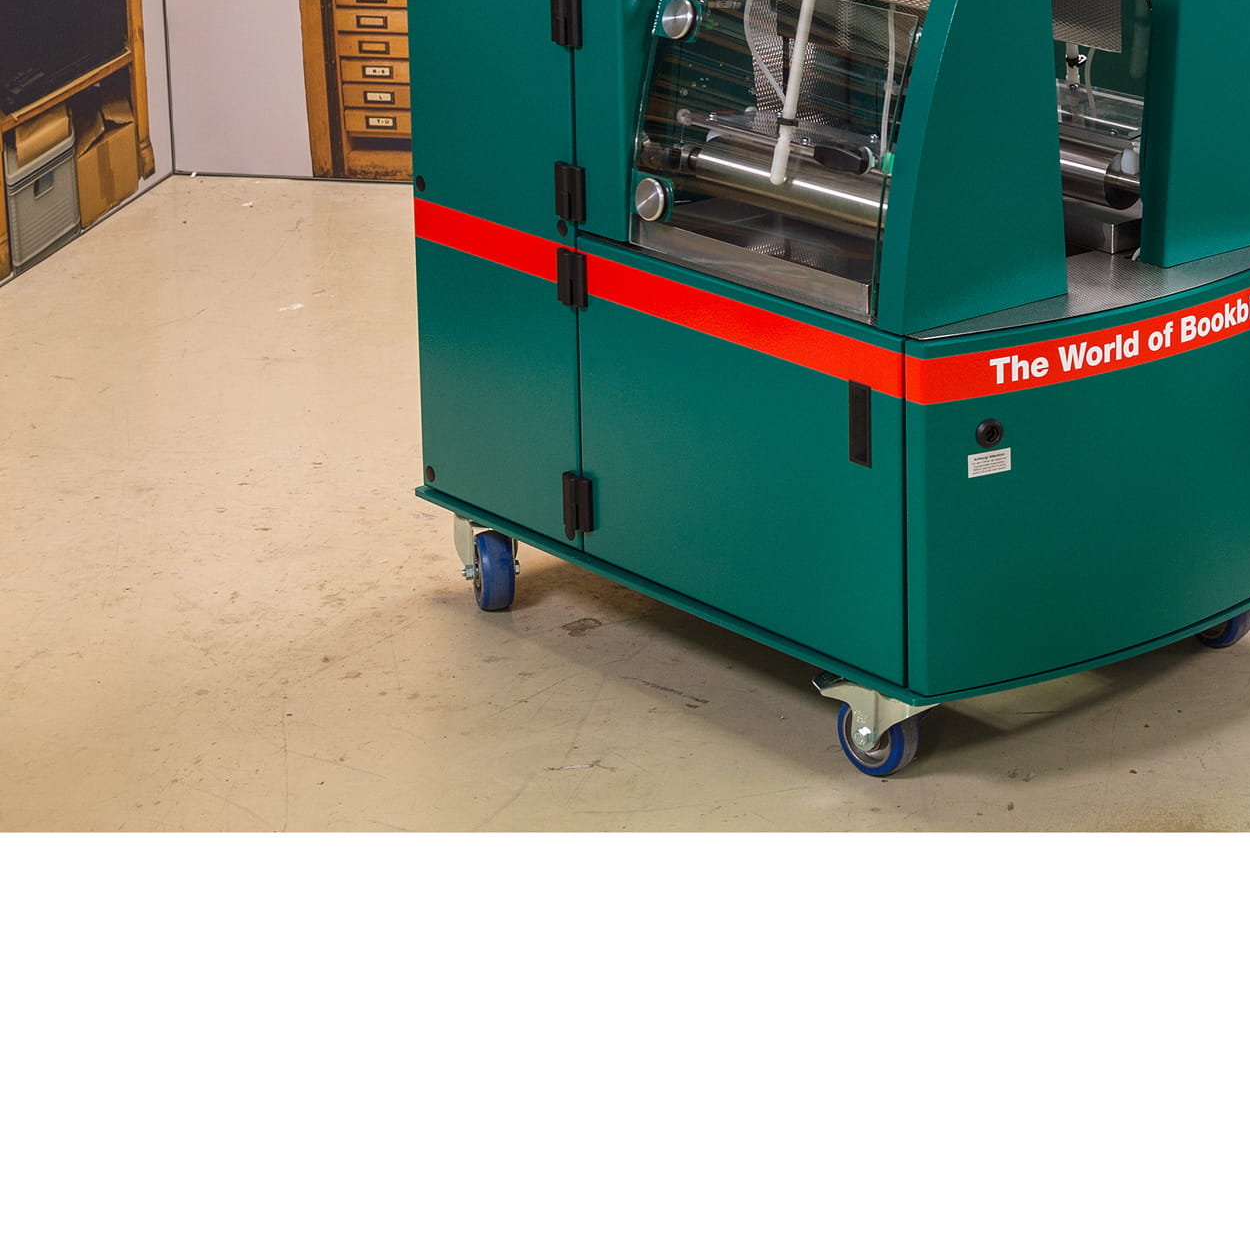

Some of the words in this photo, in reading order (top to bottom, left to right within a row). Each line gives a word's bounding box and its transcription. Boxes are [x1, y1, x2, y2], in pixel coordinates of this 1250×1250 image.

[989, 353, 1049, 385] The
[1057, 329, 1140, 372] World
[1147, 321, 1173, 351] of
